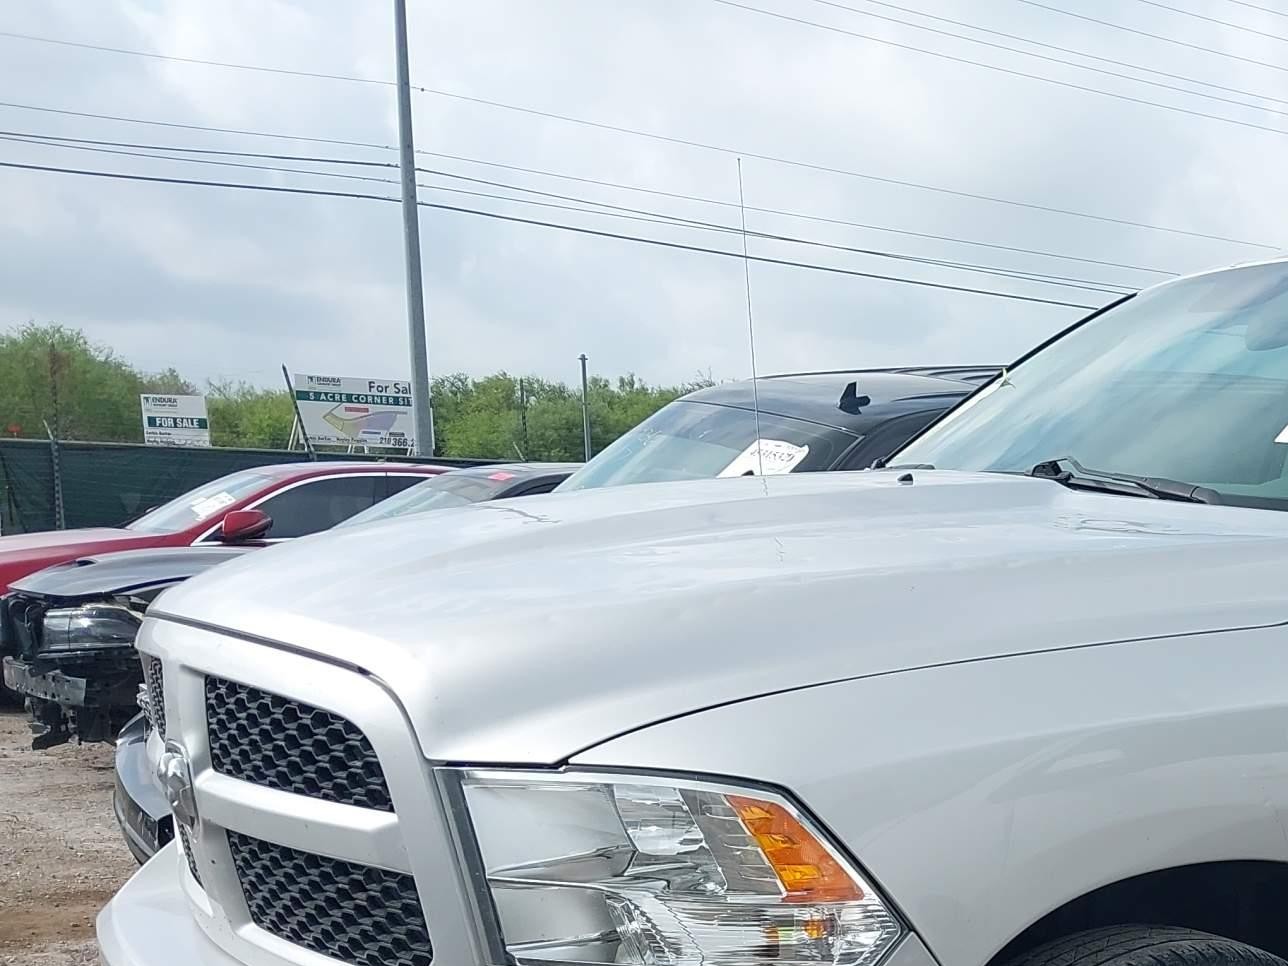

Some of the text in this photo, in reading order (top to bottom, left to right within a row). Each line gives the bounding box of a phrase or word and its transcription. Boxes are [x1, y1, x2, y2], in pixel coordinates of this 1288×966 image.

[368, 381, 412, 395] For Sal
[319, 393, 347, 402] ACRE
[352, 394, 394, 405] CORNER
[398, 397, 413, 406] SIT
[155, 417, 200, 429] FOR SALE
